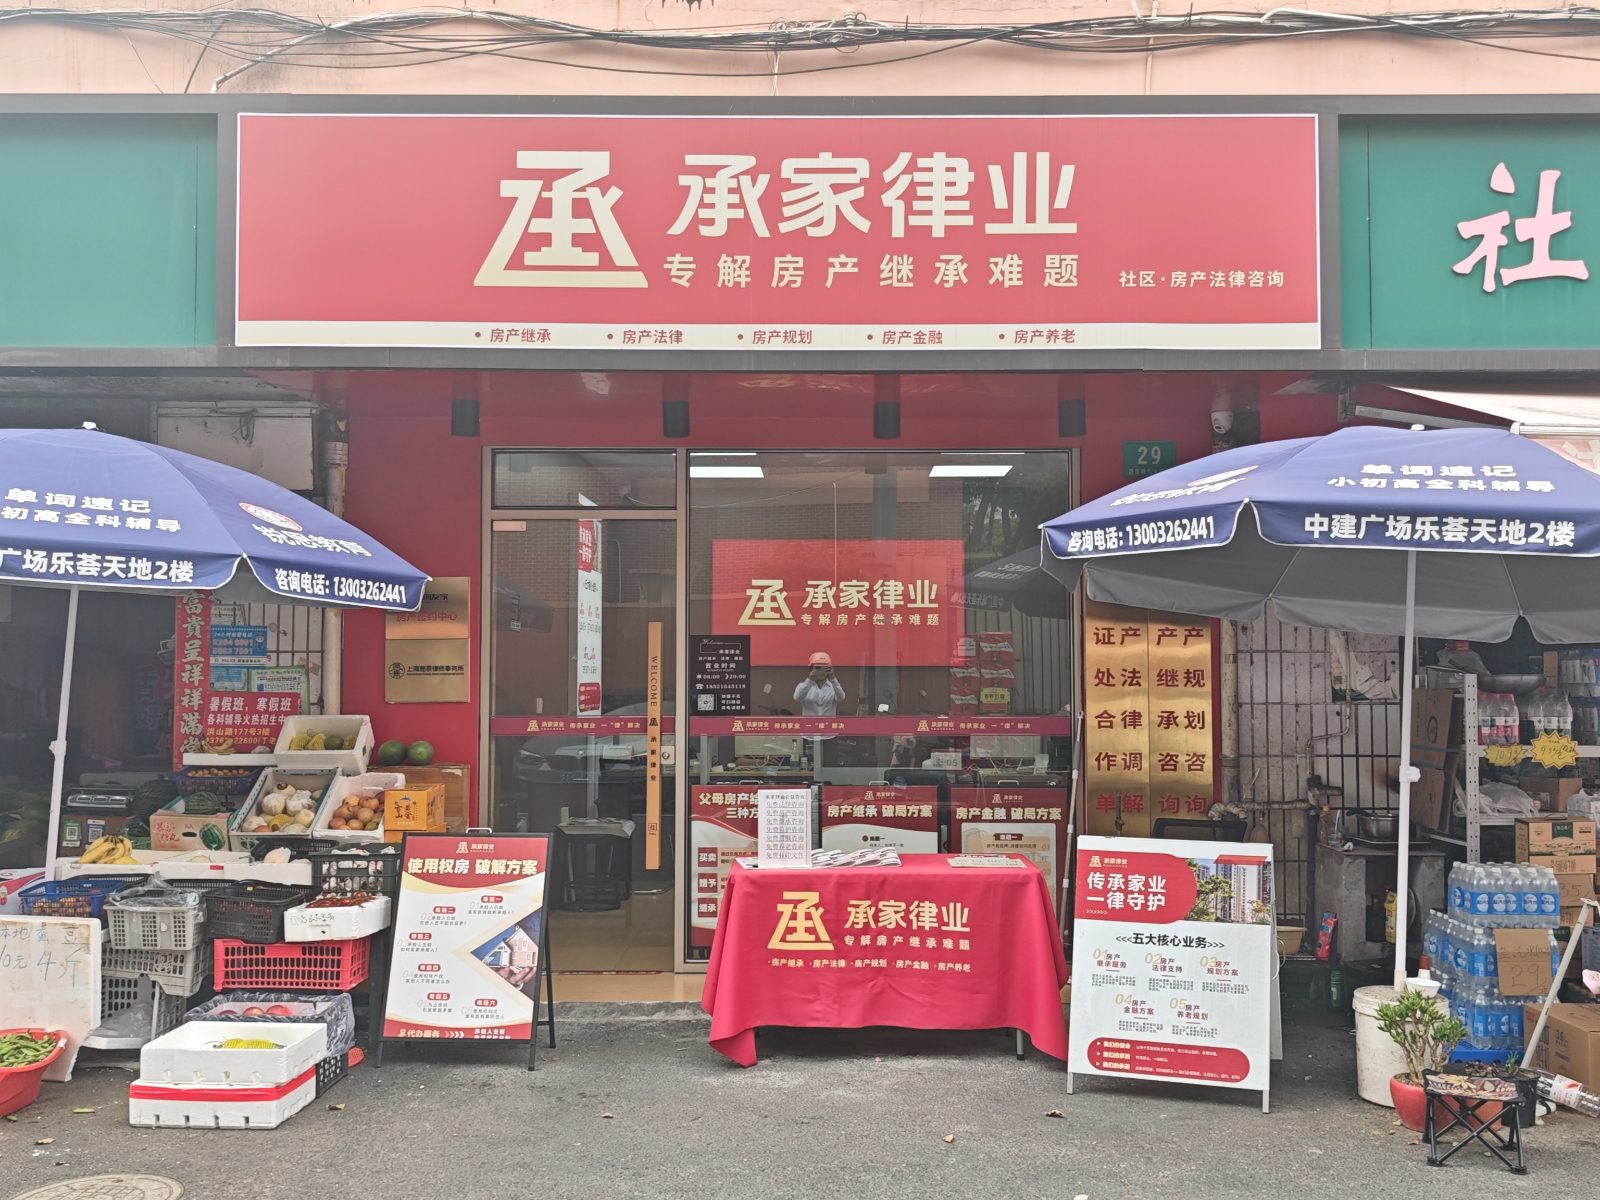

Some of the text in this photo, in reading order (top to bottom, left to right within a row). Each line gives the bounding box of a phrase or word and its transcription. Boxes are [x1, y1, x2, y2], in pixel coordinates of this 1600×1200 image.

[666, 151, 1078, 238] 承家律业
[1452, 162, 1590, 293] 社
[663, 253, 1080, 289] 专解房产继承难题
[1119, 270, 1285, 289] 社区·房产法律咨询
[489, 328, 1076, 345] 房产继承 房产法律 房产规划 房产金融 房产养老
[1137, 446, 1161, 465] 29
[1360, 464, 1517, 477] 单词速记
[1327, 477, 1556, 493] 小初高全科辅导
[4, 488, 152, 513] 单词速记
[0, 505, 182, 533] 初高全科辅导
[1304, 513, 1576, 548] 中建广场乐荟天地2楼
[0, 548, 195, 583] 广场乐荟天地2楼
[802, 580, 939, 609] 承家律业
[801, 614, 940, 626] 专解房产继承难题
[828, 805, 933, 818] 房产继承 破局方案
[956, 807, 1062, 820] 房产金融 破局方案
[407, 858, 538, 875] 使用权房 破解方案
[1087, 872, 1166, 893] 传承家业
[1086, 893, 1166, 911] 一律守护
[844, 899, 971, 932] 承家律业
[844, 935, 971, 951] 专解房产继承难题
[771, 958, 971, 972] 房产继承 房产法律 房产规划 房产金融 房产养老
[1152, 965, 1183, 973] 法律支持
[1207, 967, 1239, 976] 规划方案
[1177, 1011, 1208, 1020] 养老规划
